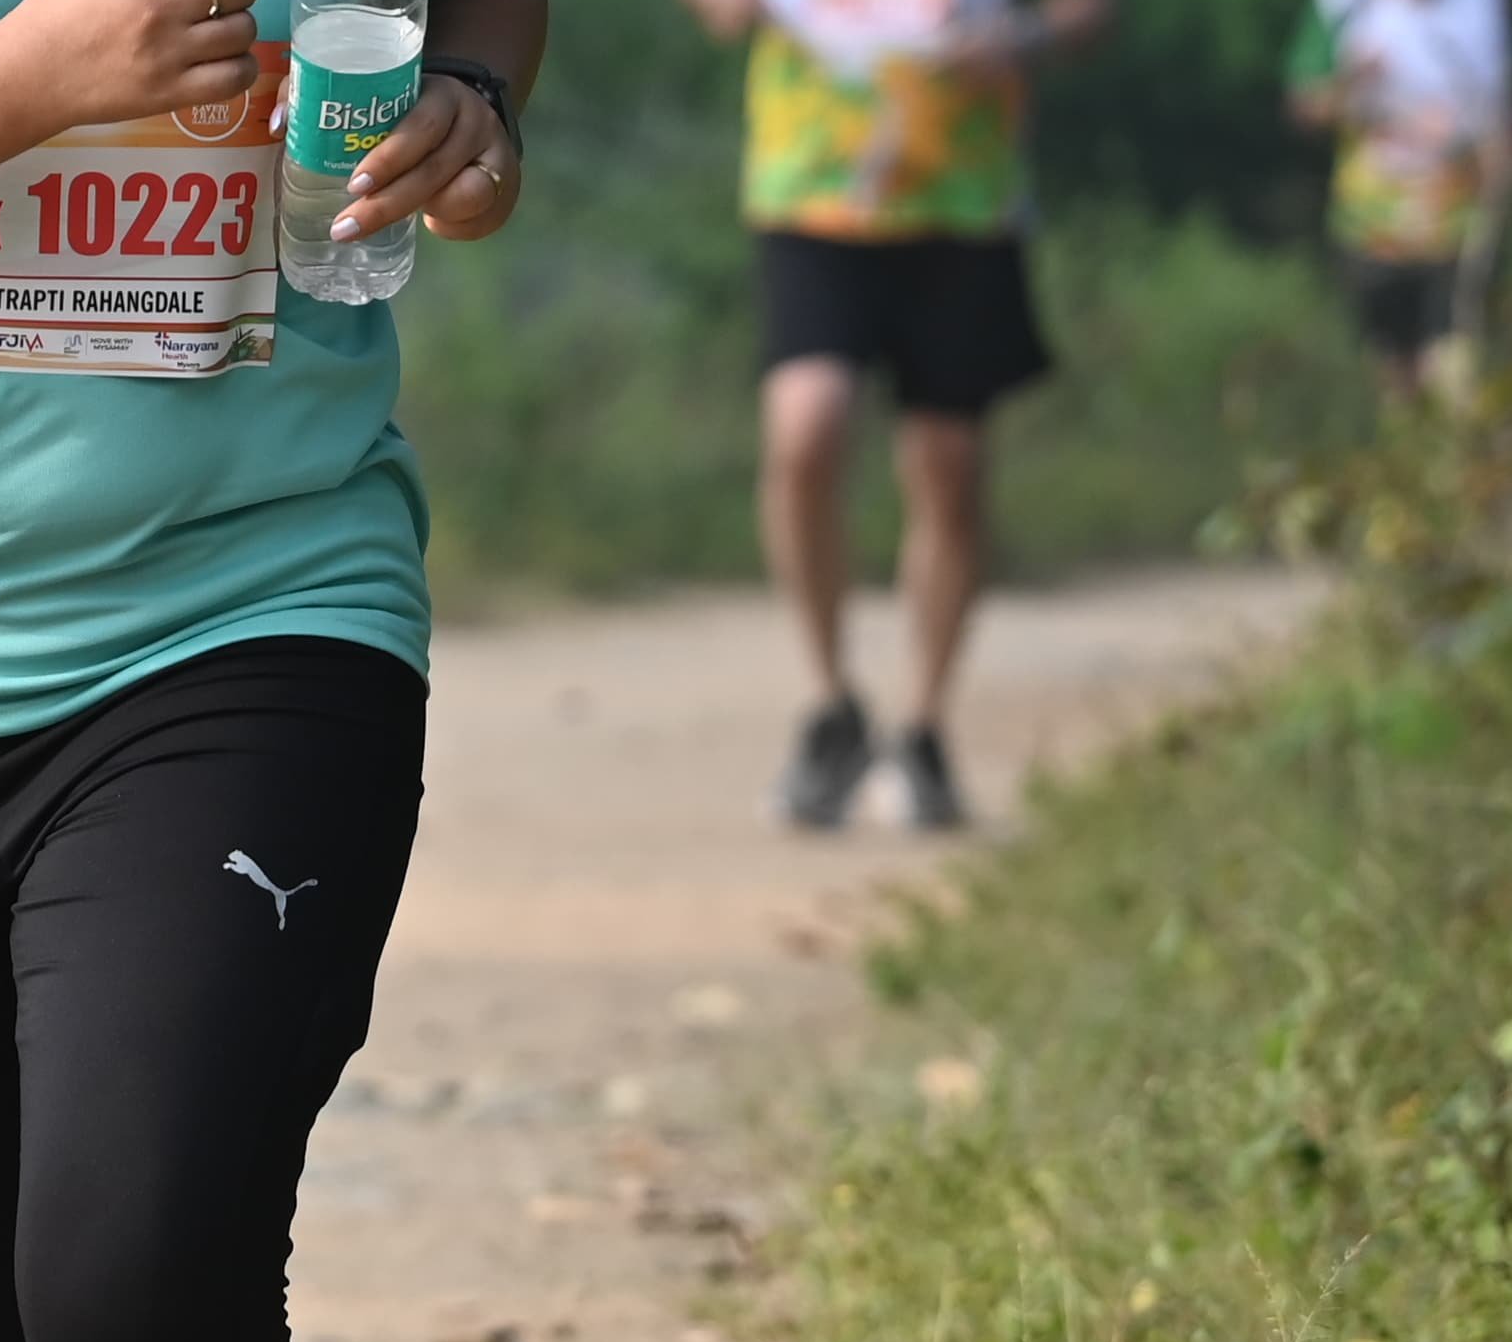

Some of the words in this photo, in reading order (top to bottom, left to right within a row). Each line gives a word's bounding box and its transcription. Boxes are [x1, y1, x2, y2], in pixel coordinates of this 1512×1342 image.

[318, 83, 411, 130] Bisleri
[27, 171, 258, 257] 10223
[72, 290, 205, 314] RAHANGDALE
[162, 340, 219, 353] Narayana
